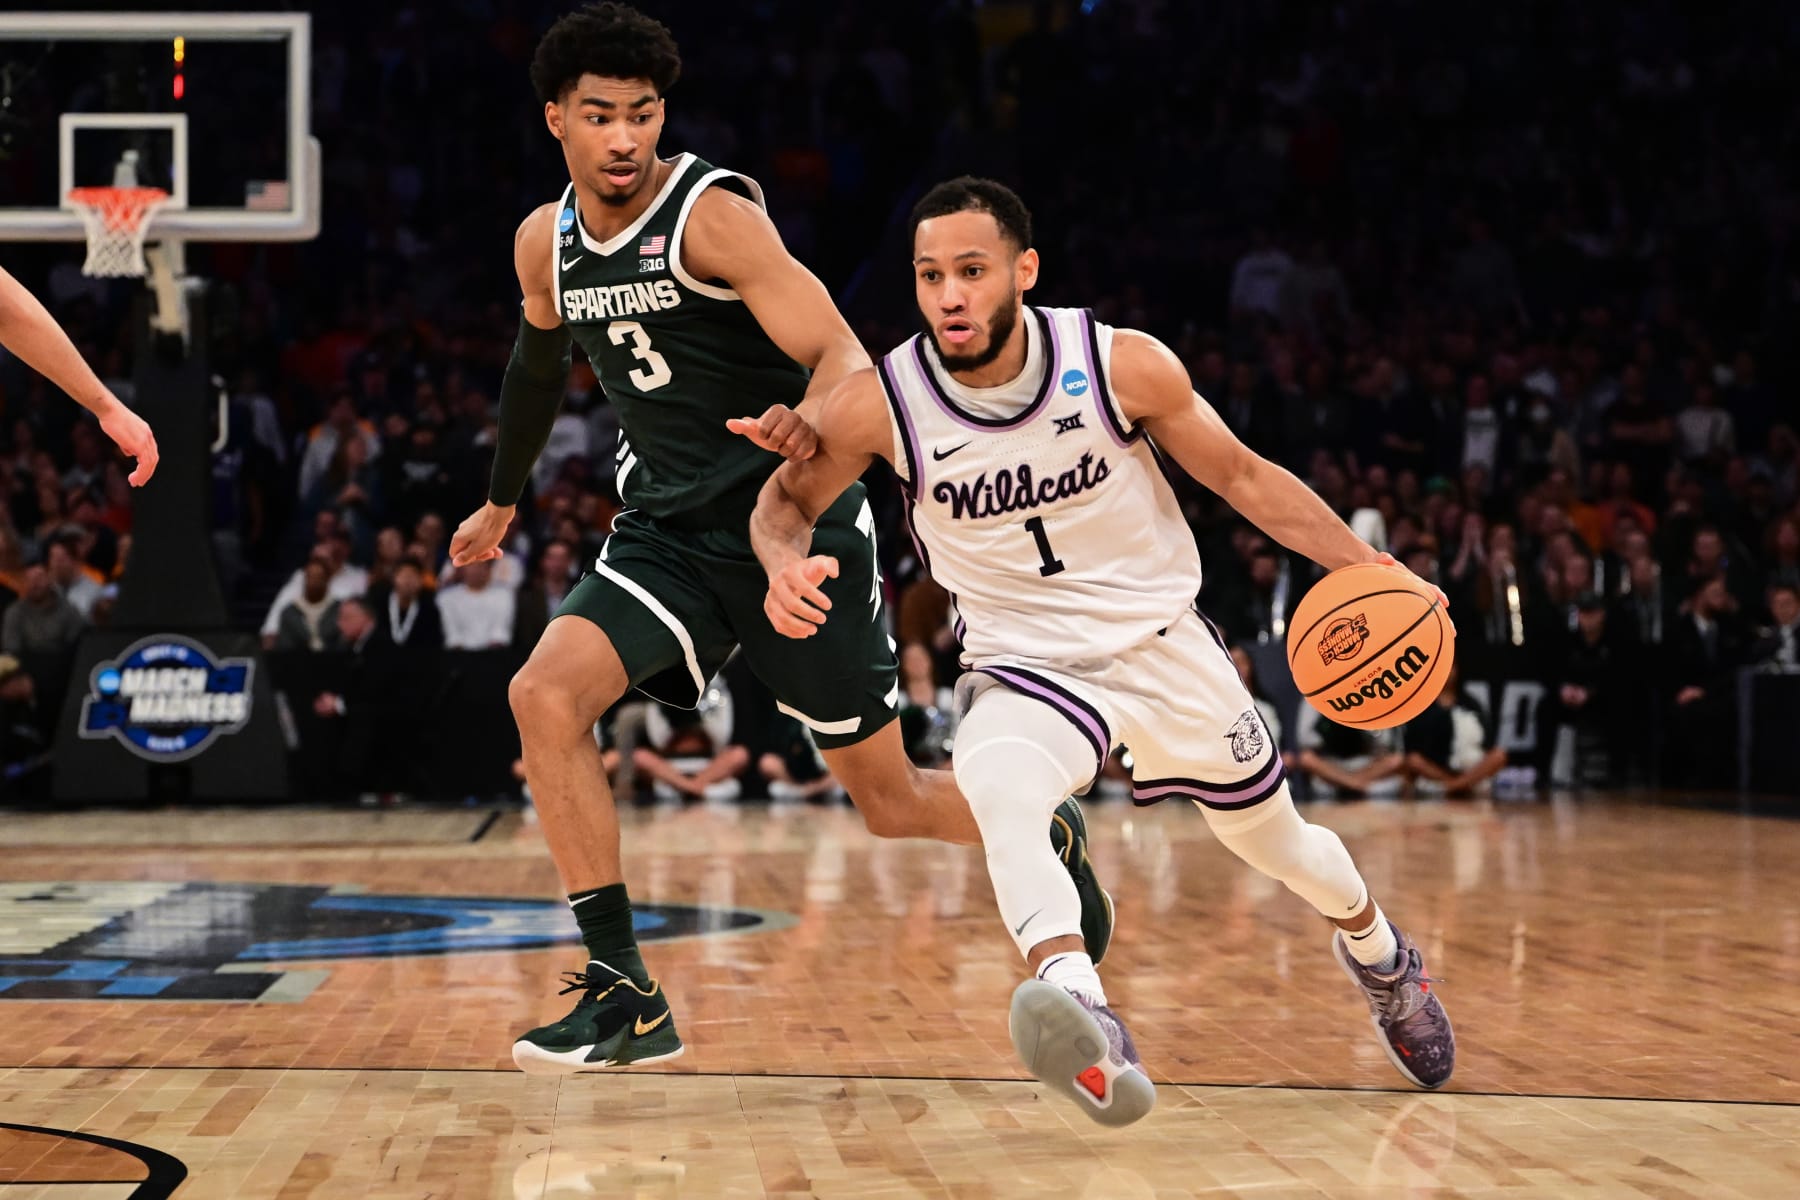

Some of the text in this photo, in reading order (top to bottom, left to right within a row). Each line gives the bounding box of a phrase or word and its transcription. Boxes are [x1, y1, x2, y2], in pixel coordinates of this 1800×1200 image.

[563, 279, 682, 321] SPARTANS
[607, 321, 672, 393] 3
[1066, 379, 1088, 392] NCAA
[1053, 410, 1087, 438] XII
[933, 448, 1112, 520] Wildcats
[1024, 516, 1066, 578] 1
[1318, 624, 1352, 655] MADNESS
[1334, 631, 1361, 655] MARCH
[120, 668, 208, 697] MARCH
[1326, 645, 1430, 712] Wilson
[130, 693, 247, 722] MADNESS
